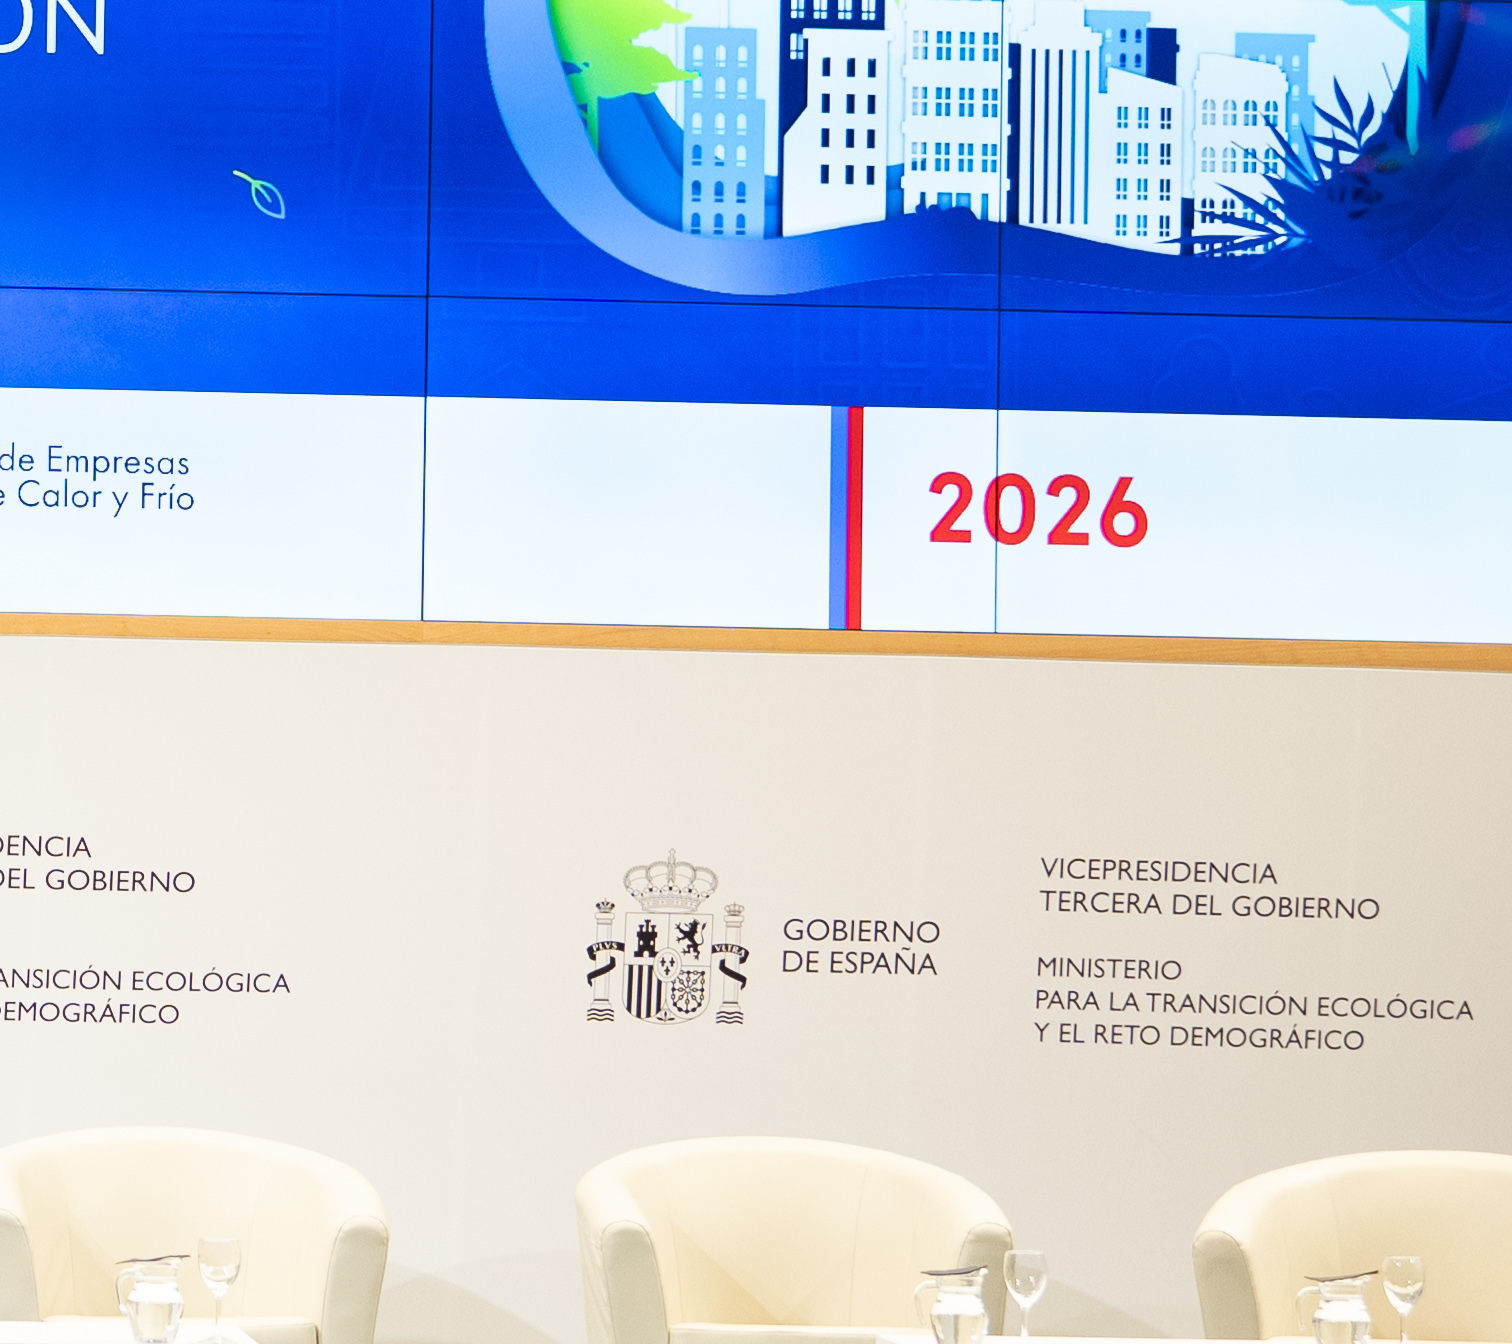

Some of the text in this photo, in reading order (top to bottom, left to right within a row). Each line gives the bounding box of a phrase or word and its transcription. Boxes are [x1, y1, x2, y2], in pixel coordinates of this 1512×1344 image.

[48, 446, 190, 481] Empresas
[18, 480, 101, 510] Calor
[113, 489, 128, 517] y
[141, 484, 195, 512] Frío
[930, 472, 1147, 547] 2026
[46, 869, 195, 892] GOBIERNO
[1041, 858, 1277, 884] VICEPRESIDENCIA
[1040, 891, 1379, 919] TERCERA DEL GOBIERNO
[784, 919, 939, 943] GOBIERNO
[783, 947, 937, 975] DE ESPAÑA
[1038, 957, 1181, 980] MINISTERIO
[133, 971, 290, 993] ECOLÓGICA
[1037, 990, 1473, 1020] PARA LA TRANSICIÓN ECOLÓGICA
[1035, 1023, 1364, 1050] Y EL RETO DEMOGRÁFICO
